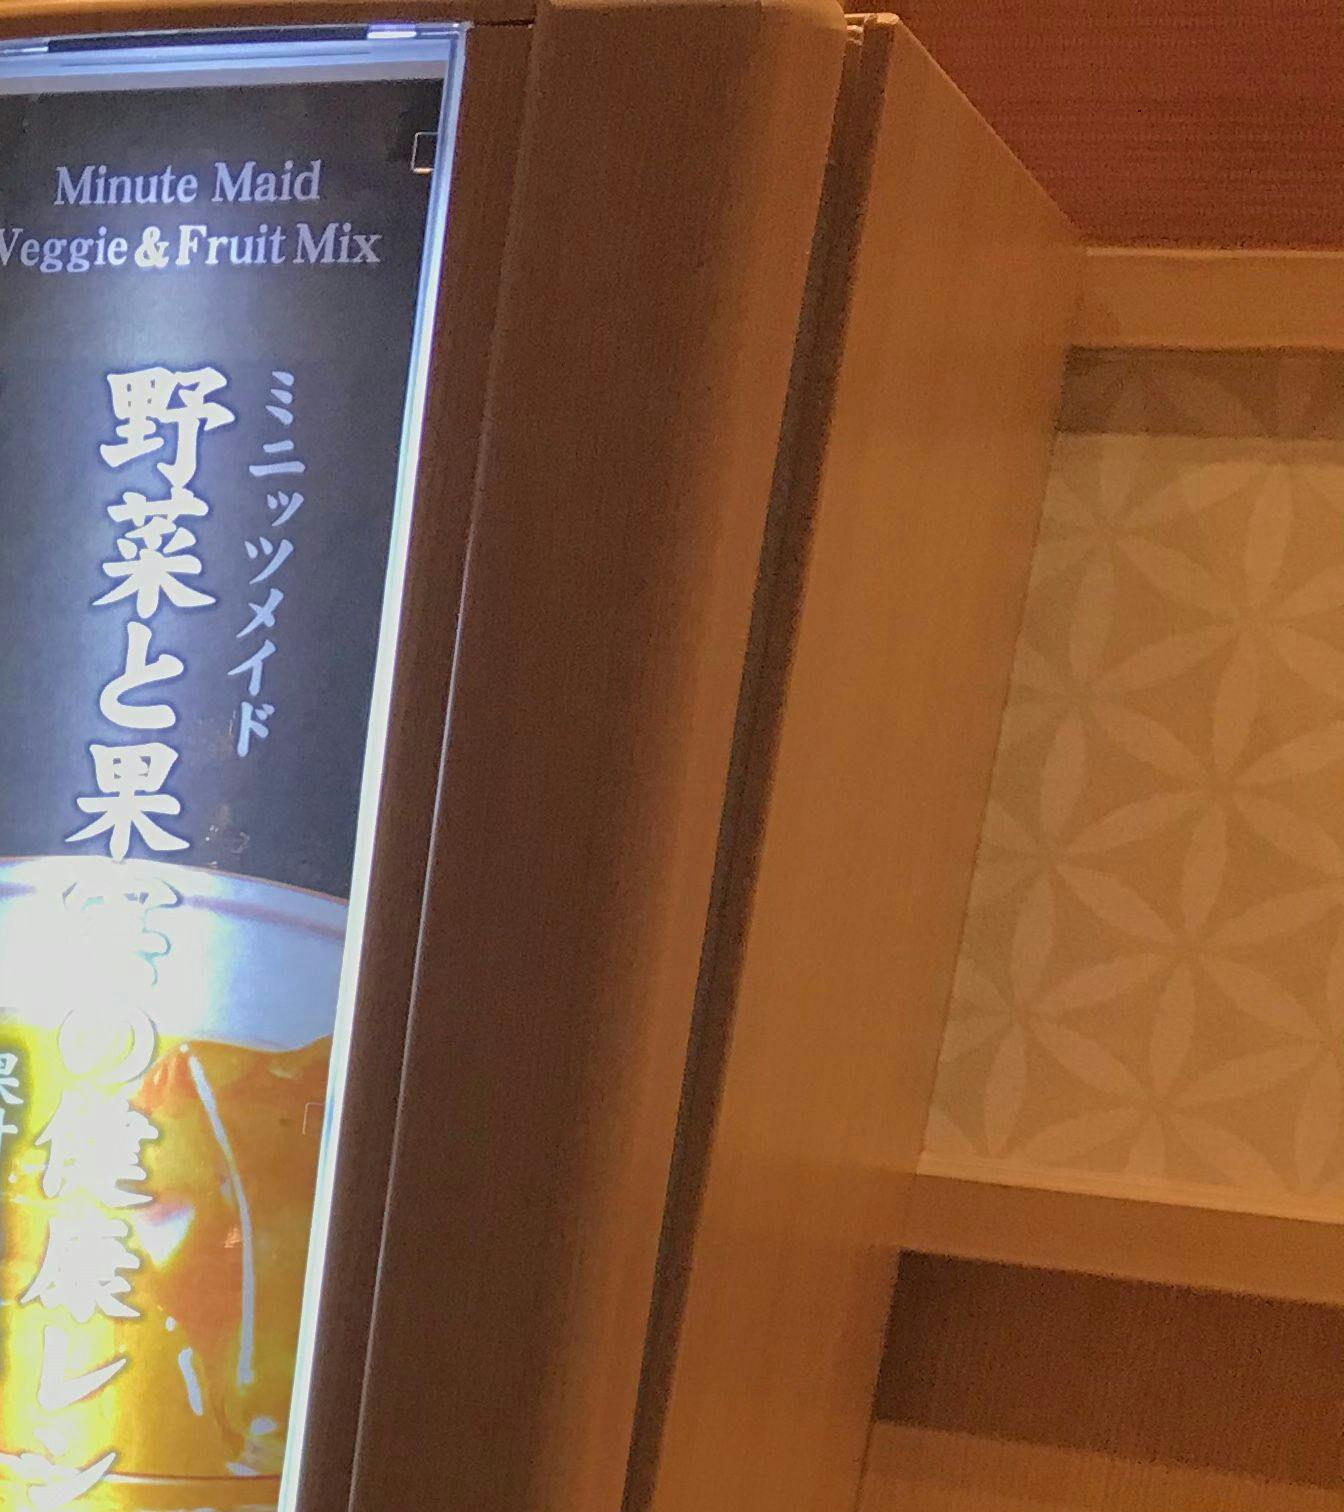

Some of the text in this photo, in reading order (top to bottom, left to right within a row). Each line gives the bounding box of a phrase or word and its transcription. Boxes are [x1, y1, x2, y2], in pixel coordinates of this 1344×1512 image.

[53, 159, 322, 207] Minute Maid
[175, 222, 286, 269] Fruit
[293, 222, 382, 267] Mix
[226, 369, 307, 760] ミニッツメイド
